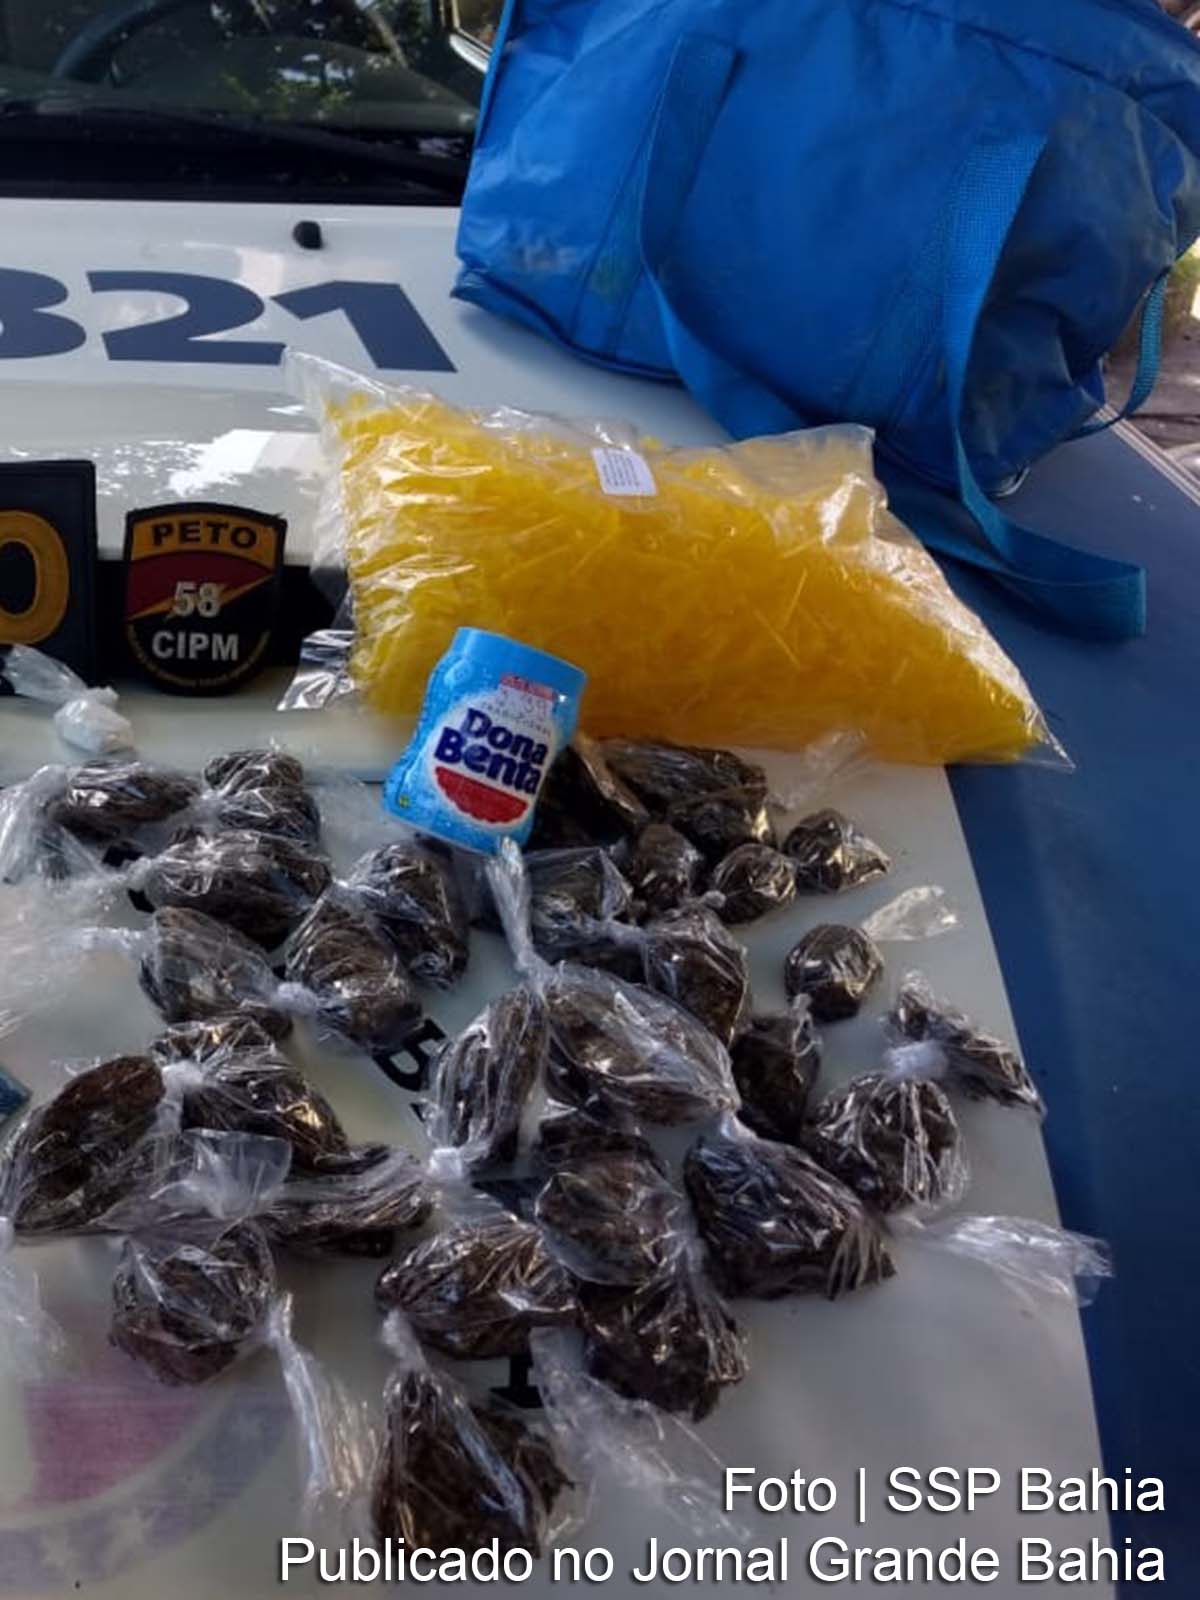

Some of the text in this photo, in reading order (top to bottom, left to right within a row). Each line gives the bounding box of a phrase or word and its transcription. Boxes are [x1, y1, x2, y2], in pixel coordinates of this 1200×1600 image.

[151, 521, 257, 548] PETO
[172, 580, 222, 618] 58
[152, 630, 239, 661] CIPM
[461, 707, 548, 766] Dona
[434, 726, 542, 794] Benta
